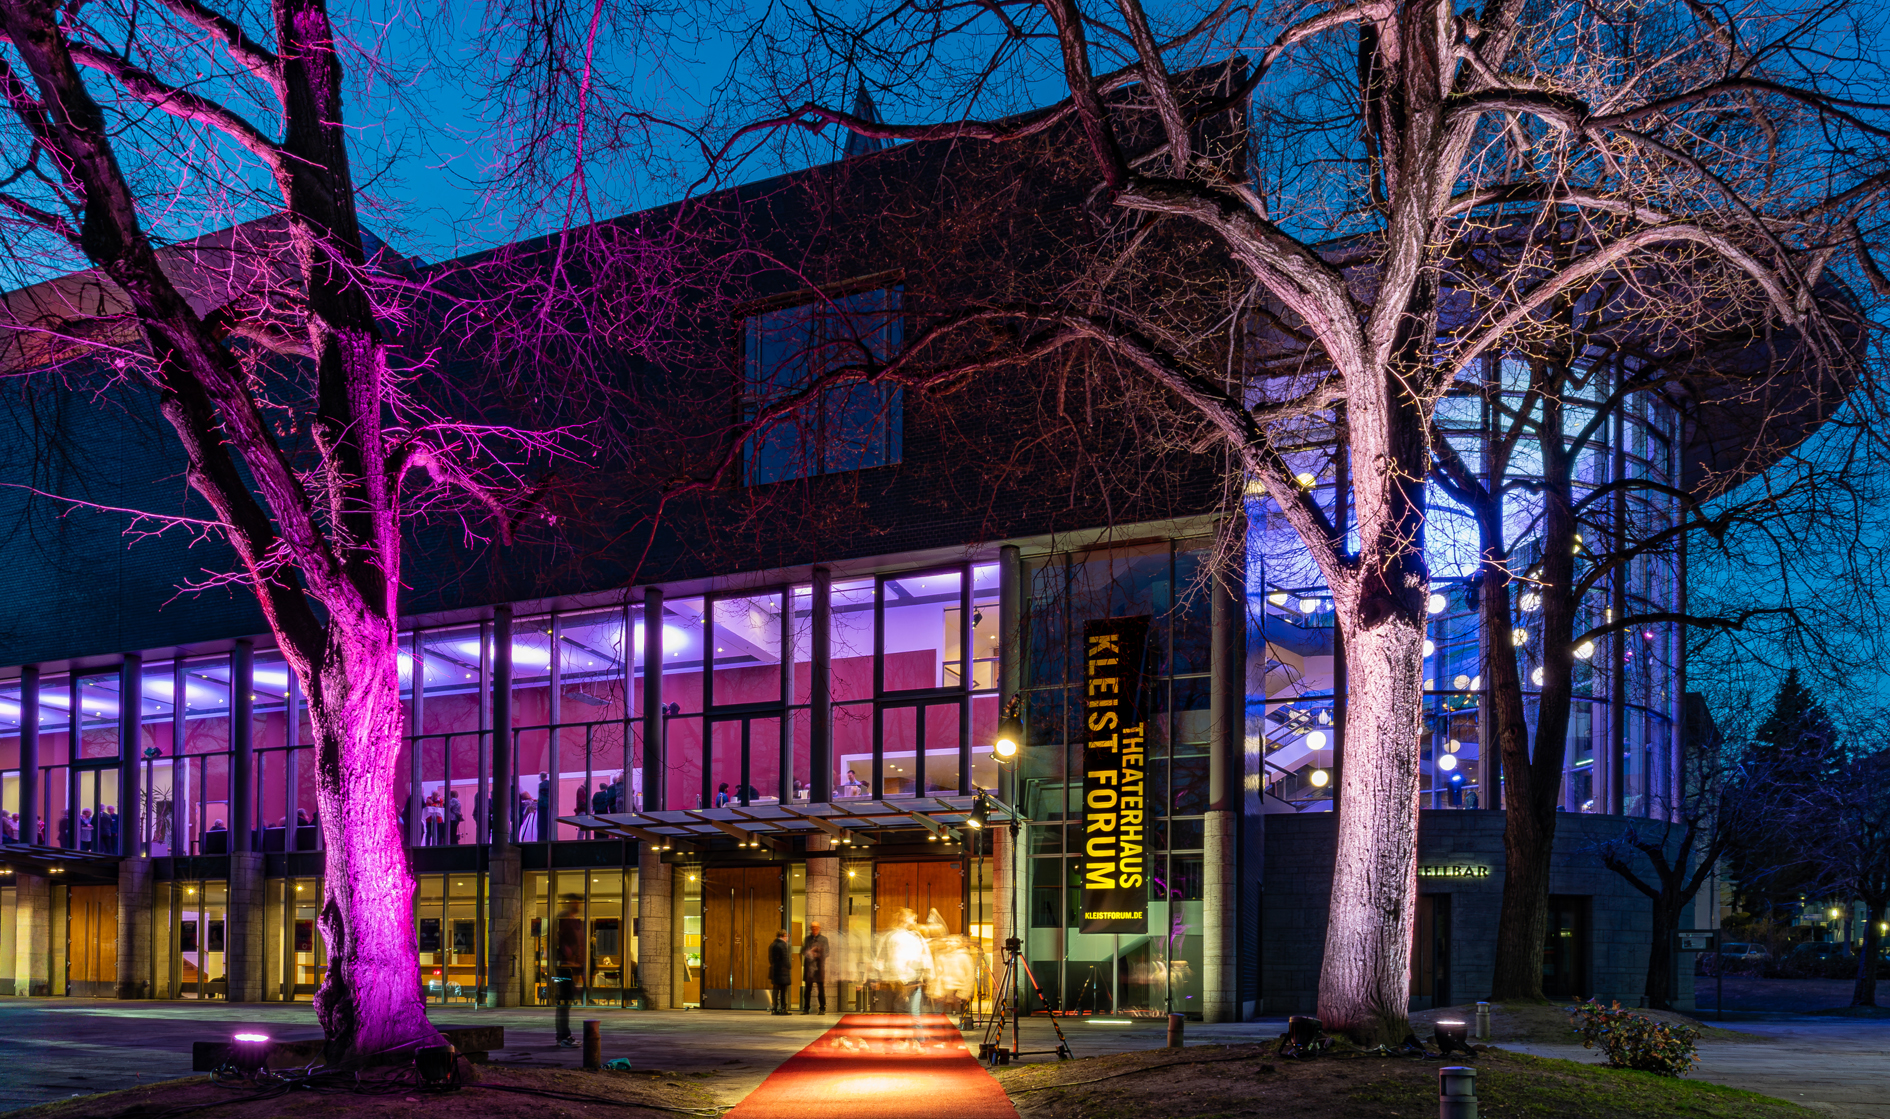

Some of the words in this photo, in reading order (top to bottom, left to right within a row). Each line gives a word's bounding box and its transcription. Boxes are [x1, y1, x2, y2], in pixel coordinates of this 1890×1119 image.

[1088, 634, 1119, 753] KLEIST
[1085, 769, 1118, 890] FORUM
[1119, 721, 1144, 889] THEATERHAUS
[1085, 911, 1143, 920] KLEISTFORUM.DE
